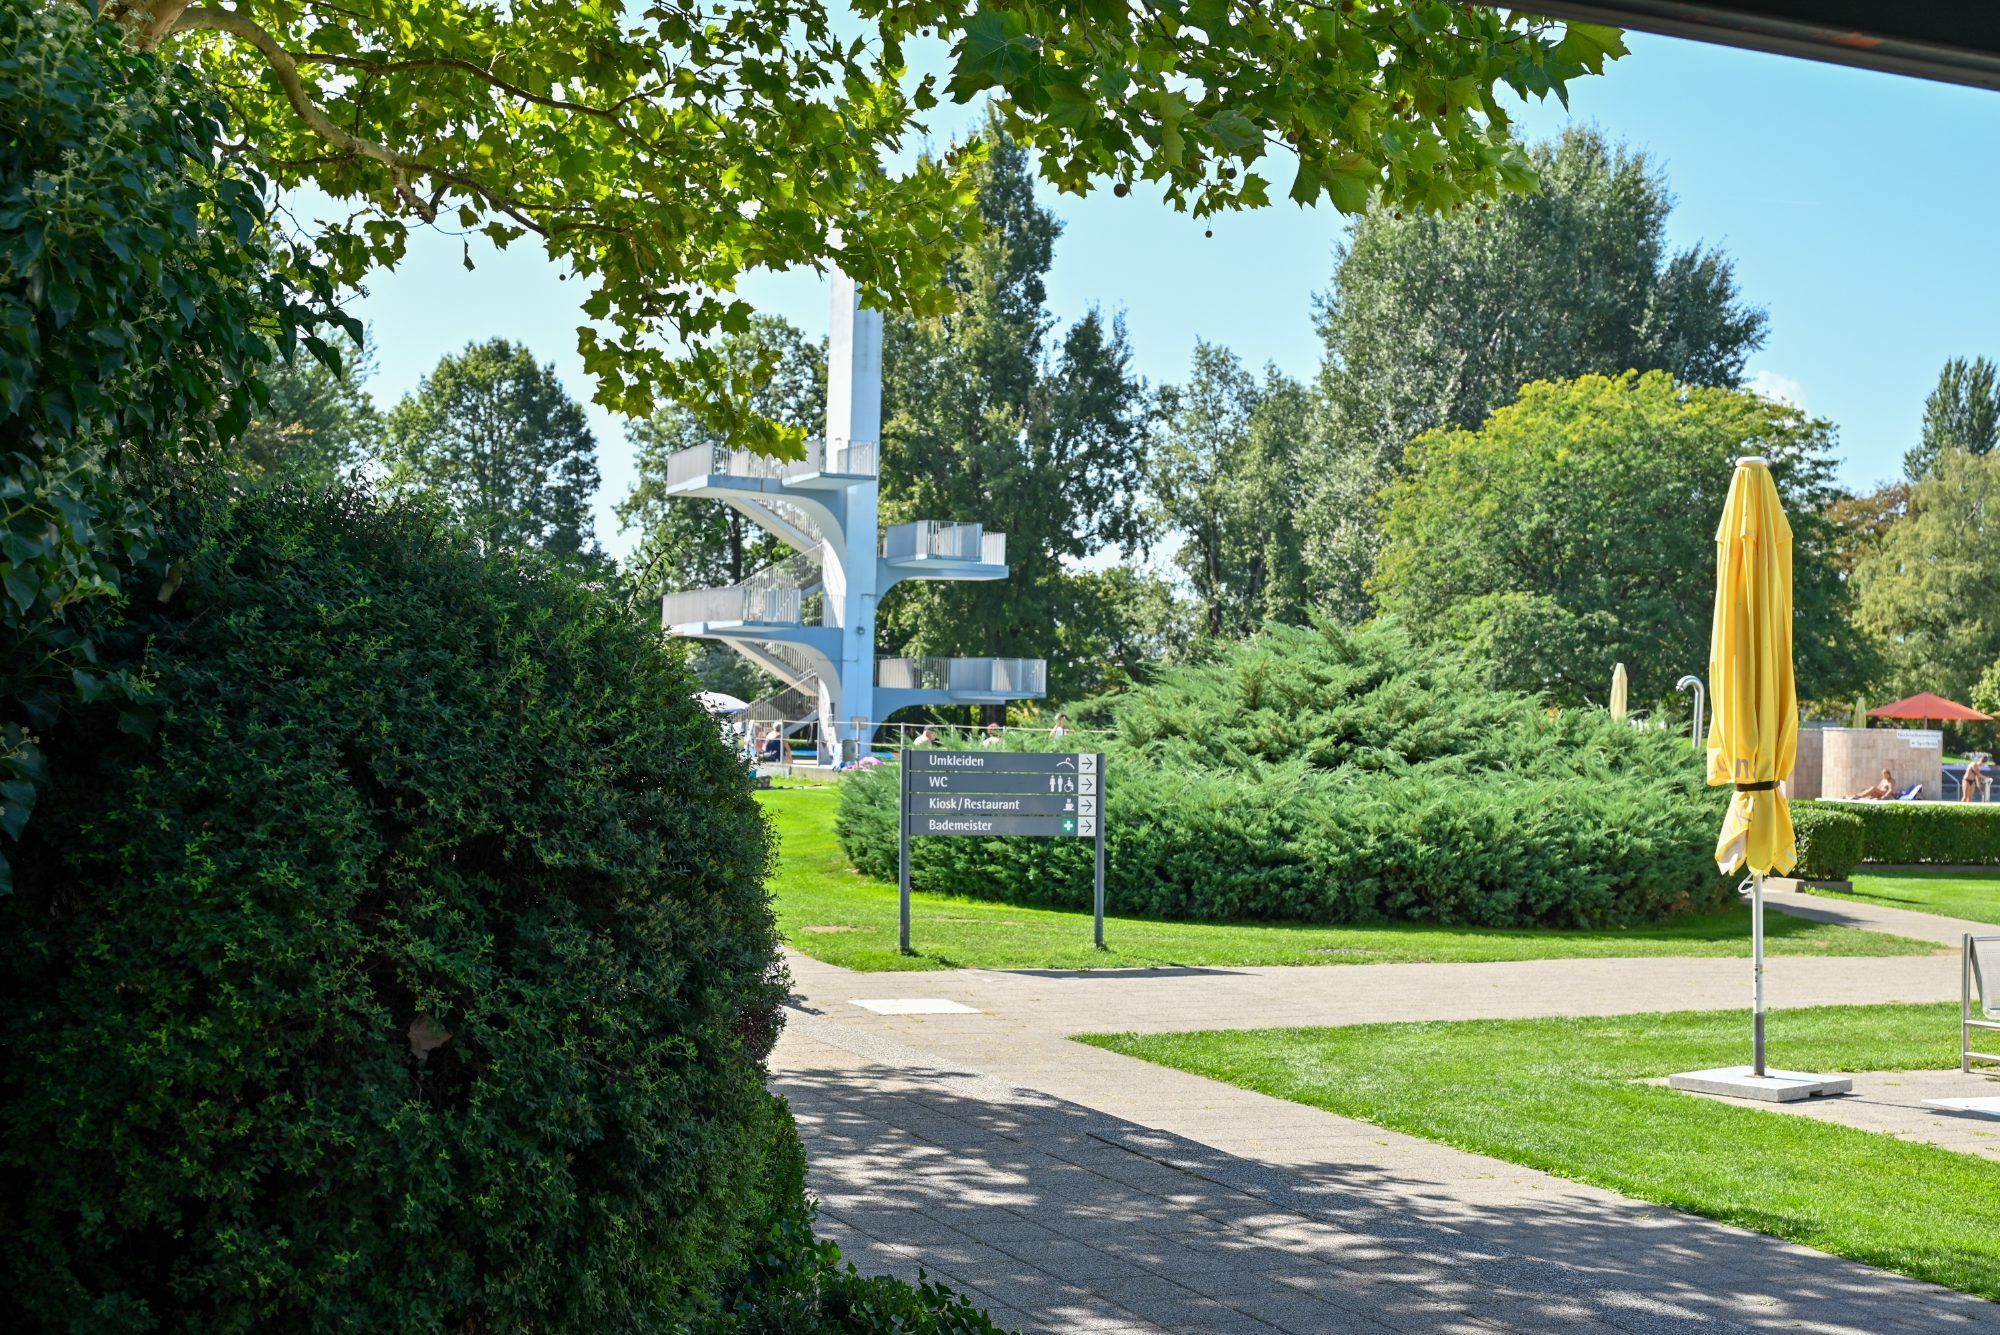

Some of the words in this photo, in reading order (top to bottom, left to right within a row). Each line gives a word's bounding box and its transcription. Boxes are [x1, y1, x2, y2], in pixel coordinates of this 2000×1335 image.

[929, 754, 984, 767] Umkleiden
[929, 776, 948, 788] WC
[929, 819, 993, 831] Bademeister
